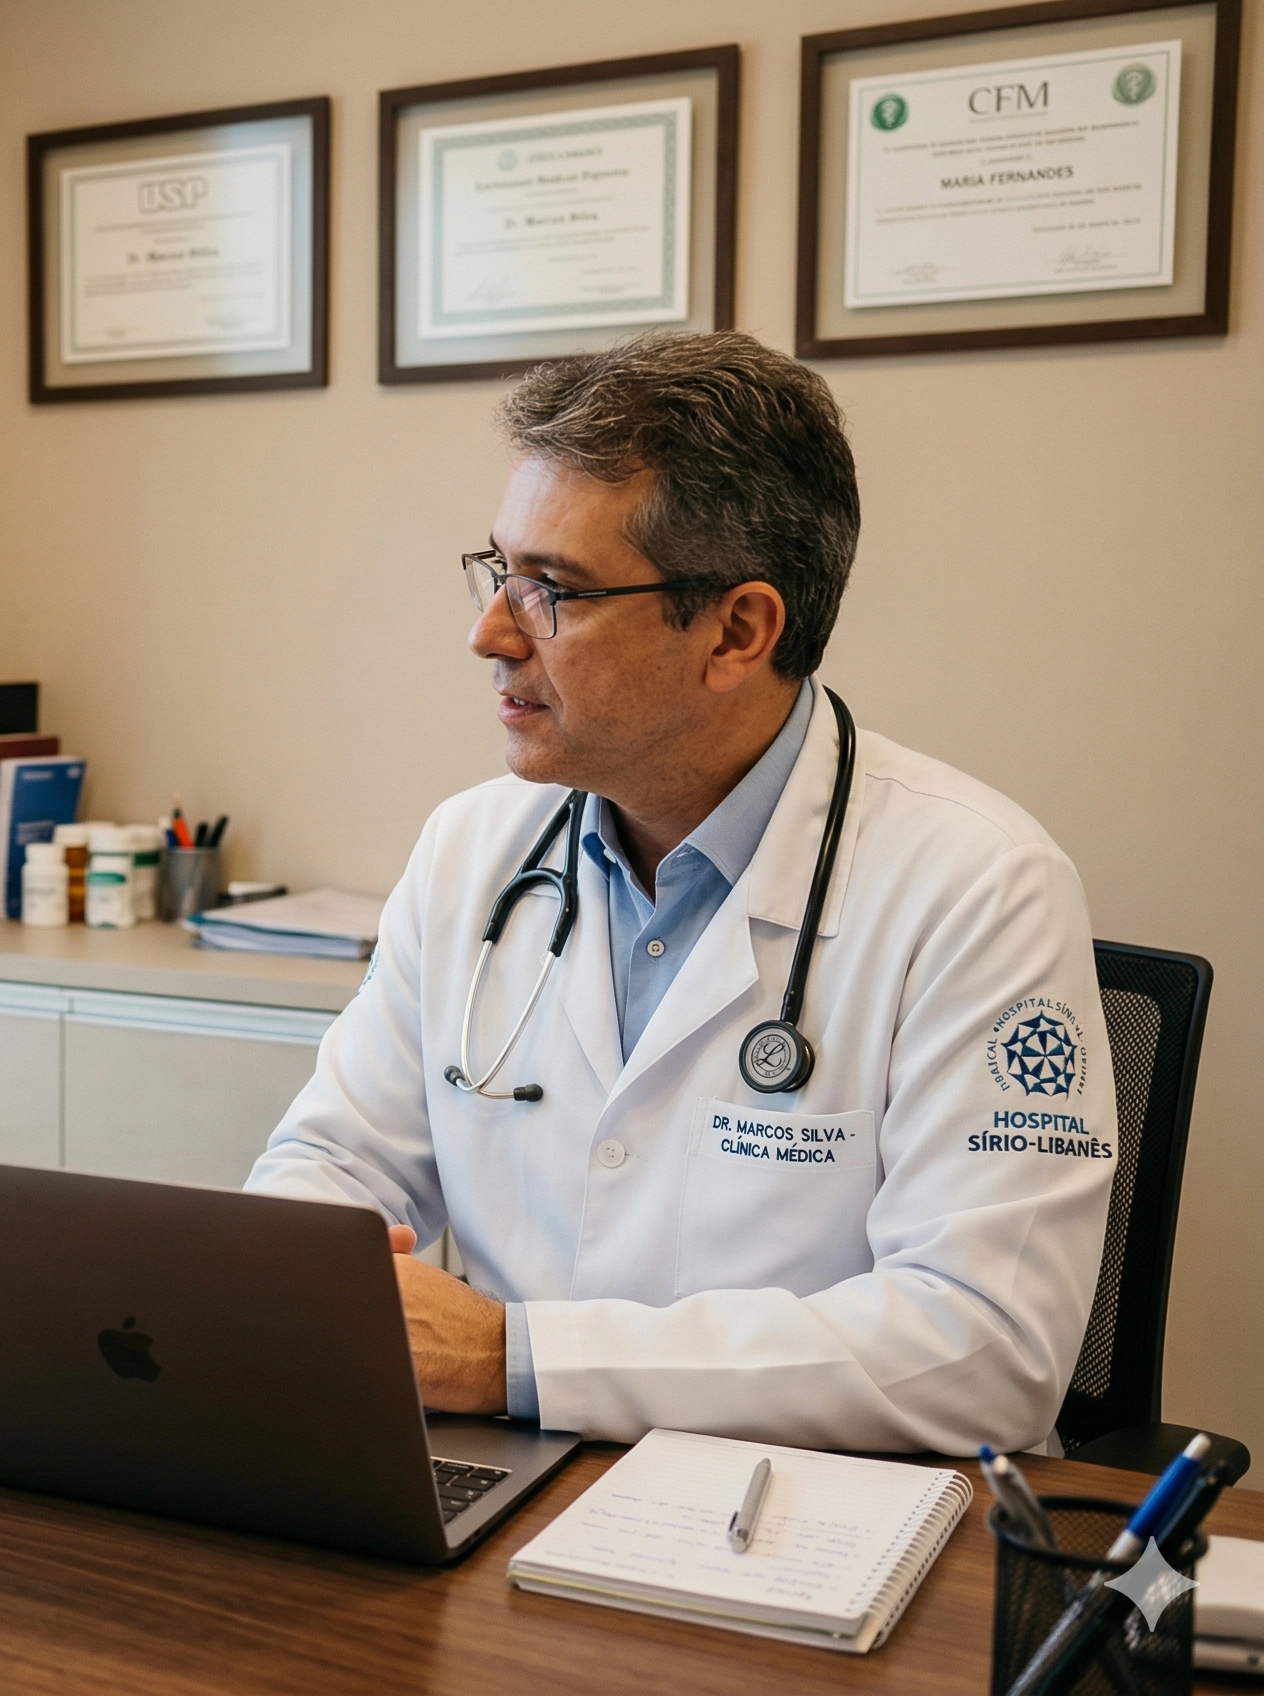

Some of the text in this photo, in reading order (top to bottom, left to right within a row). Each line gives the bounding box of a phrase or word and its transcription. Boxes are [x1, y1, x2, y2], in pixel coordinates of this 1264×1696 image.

[968, 81, 1050, 116] CFM
[137, 176, 209, 215] USP
[712, 1115, 732, 1131] DR.
[736, 1119, 794, 1141] MARCOS
[801, 1127, 845, 1143] SILVA
[993, 1111, 1090, 1135] HOSPITAL
[721, 1135, 836, 1163] CLÍNICA MÉDICA
[968, 1130, 1113, 1159] SÍRIO-LIBANÊS
